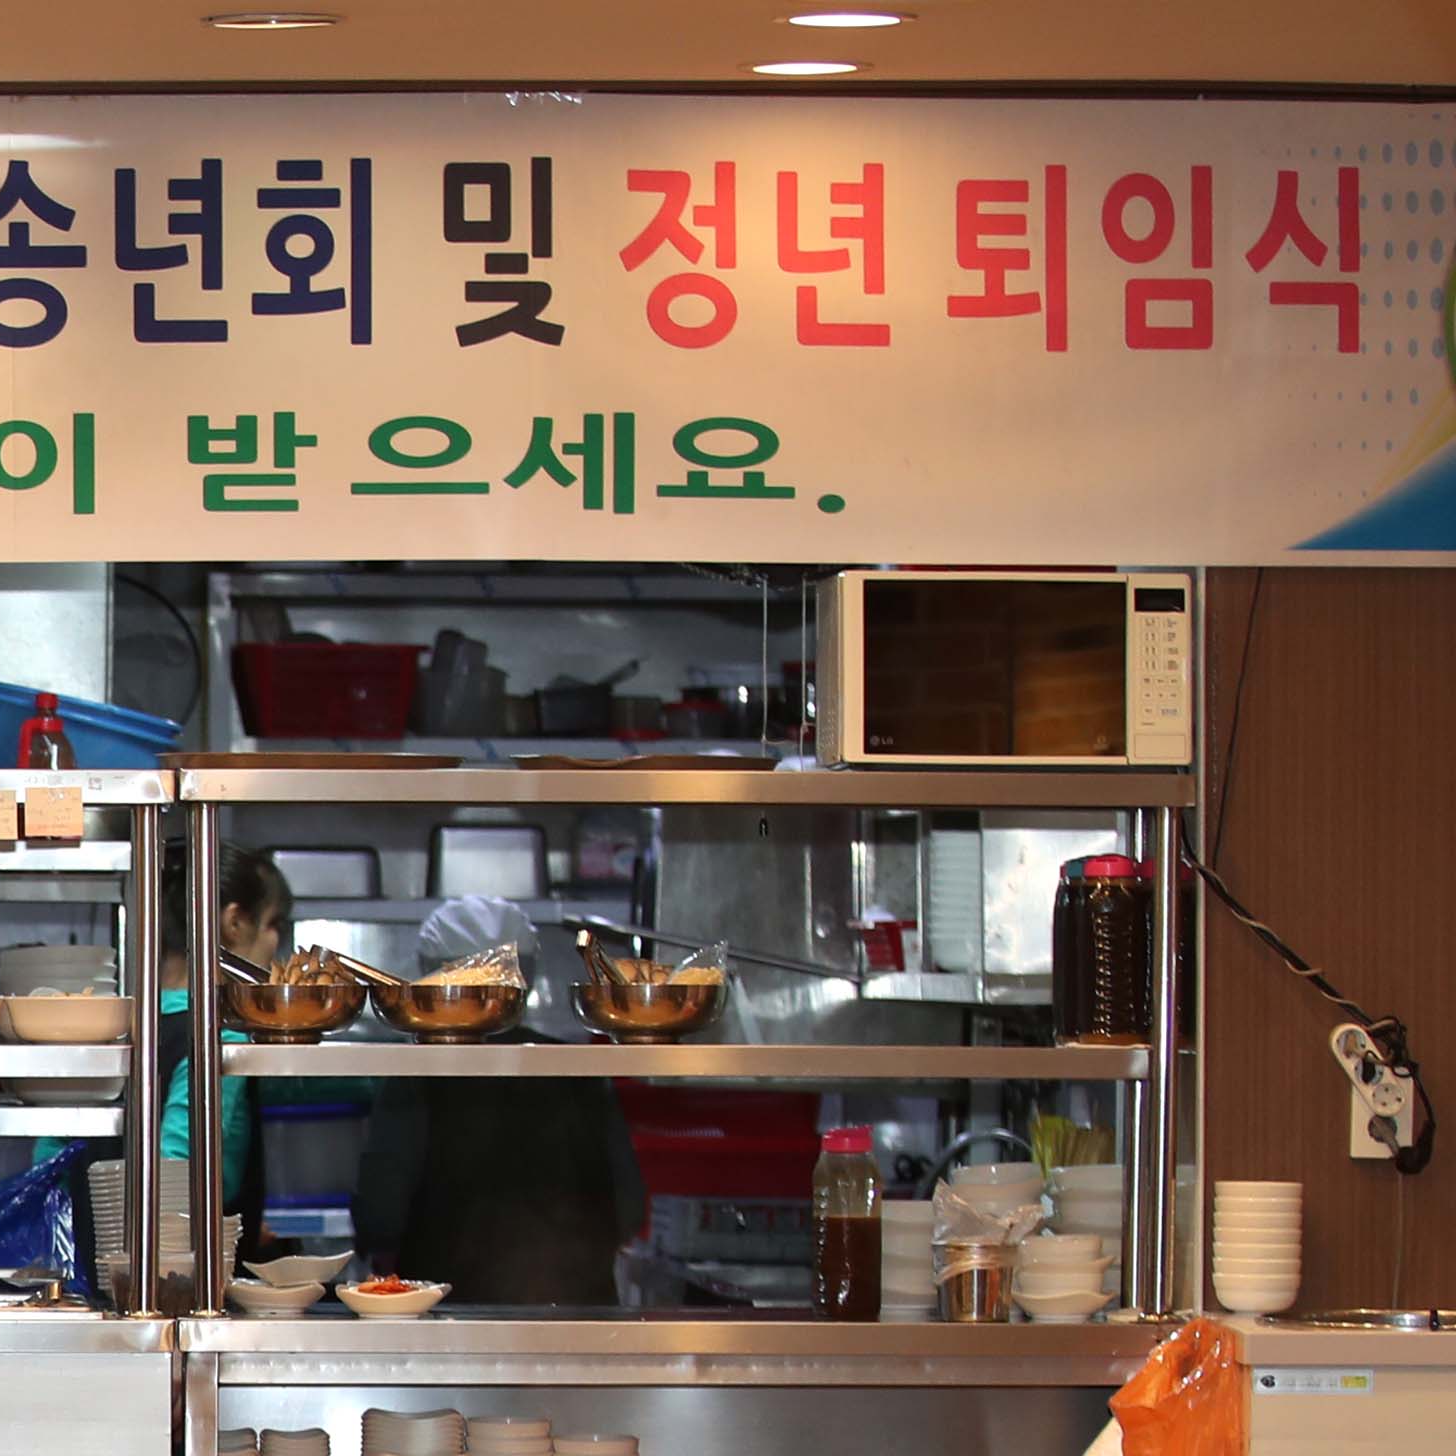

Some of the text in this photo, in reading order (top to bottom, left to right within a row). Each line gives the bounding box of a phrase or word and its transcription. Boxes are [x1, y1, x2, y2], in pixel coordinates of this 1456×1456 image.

[442, 156, 566, 348] 및
[618, 160, 892, 350] 정년
[946, 164, 1361, 353] 퇴임식
